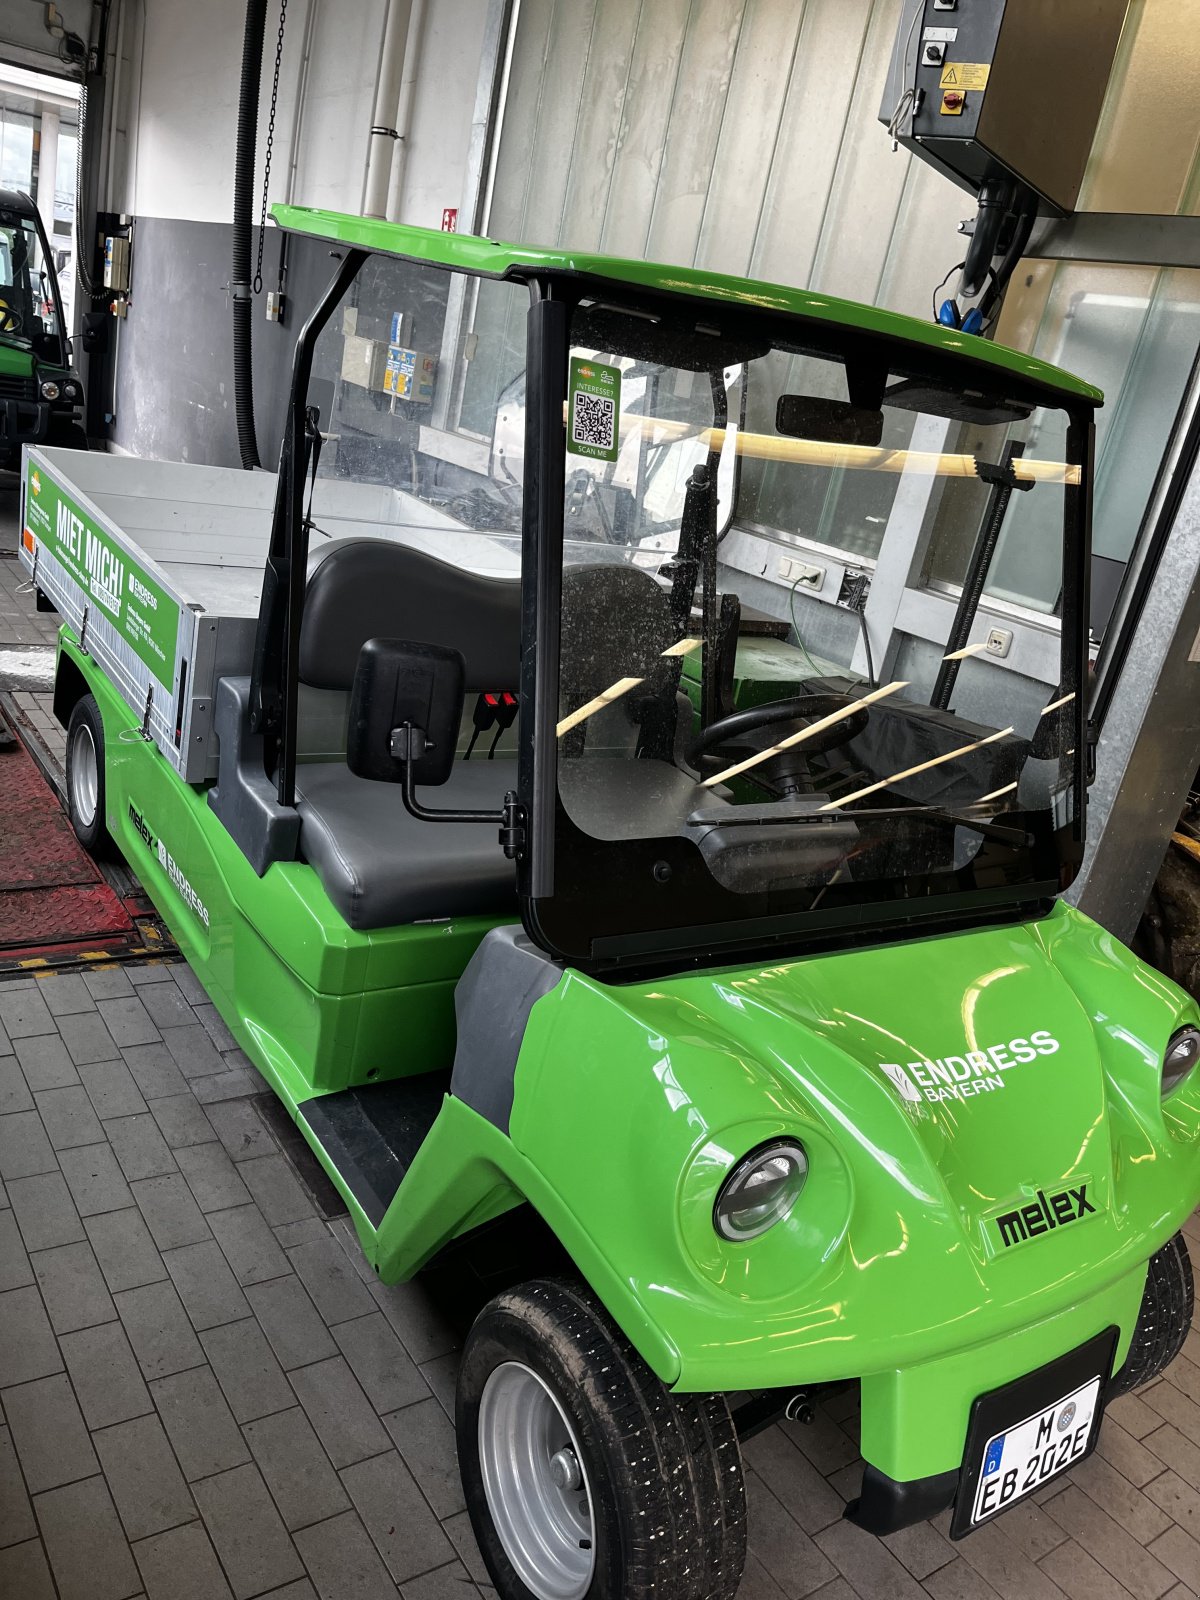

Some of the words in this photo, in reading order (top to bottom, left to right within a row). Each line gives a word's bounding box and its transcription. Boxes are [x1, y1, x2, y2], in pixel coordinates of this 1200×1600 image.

[576, 382, 614, 398] INTERESSE?
[578, 445, 597, 456] SCAN
[597, 449, 608, 458] ME
[57, 498, 85, 562] MIET
[85, 528, 124, 608] MICH!
[134, 577, 158, 611] ENDRESS
[128, 803, 153, 851] melex
[167, 852, 210, 927] ENDRESS
[907, 1030, 1060, 1087] ENDRESS
[923, 1074, 1006, 1103] BAYERN
[995, 1184, 1097, 1248] melex
[1035, 1410, 1056, 1450] M
[980, 1467, 1019, 1517] EB
[1021, 1421, 1089, 1492] 202E
[987, 1460, 997, 1473] D
